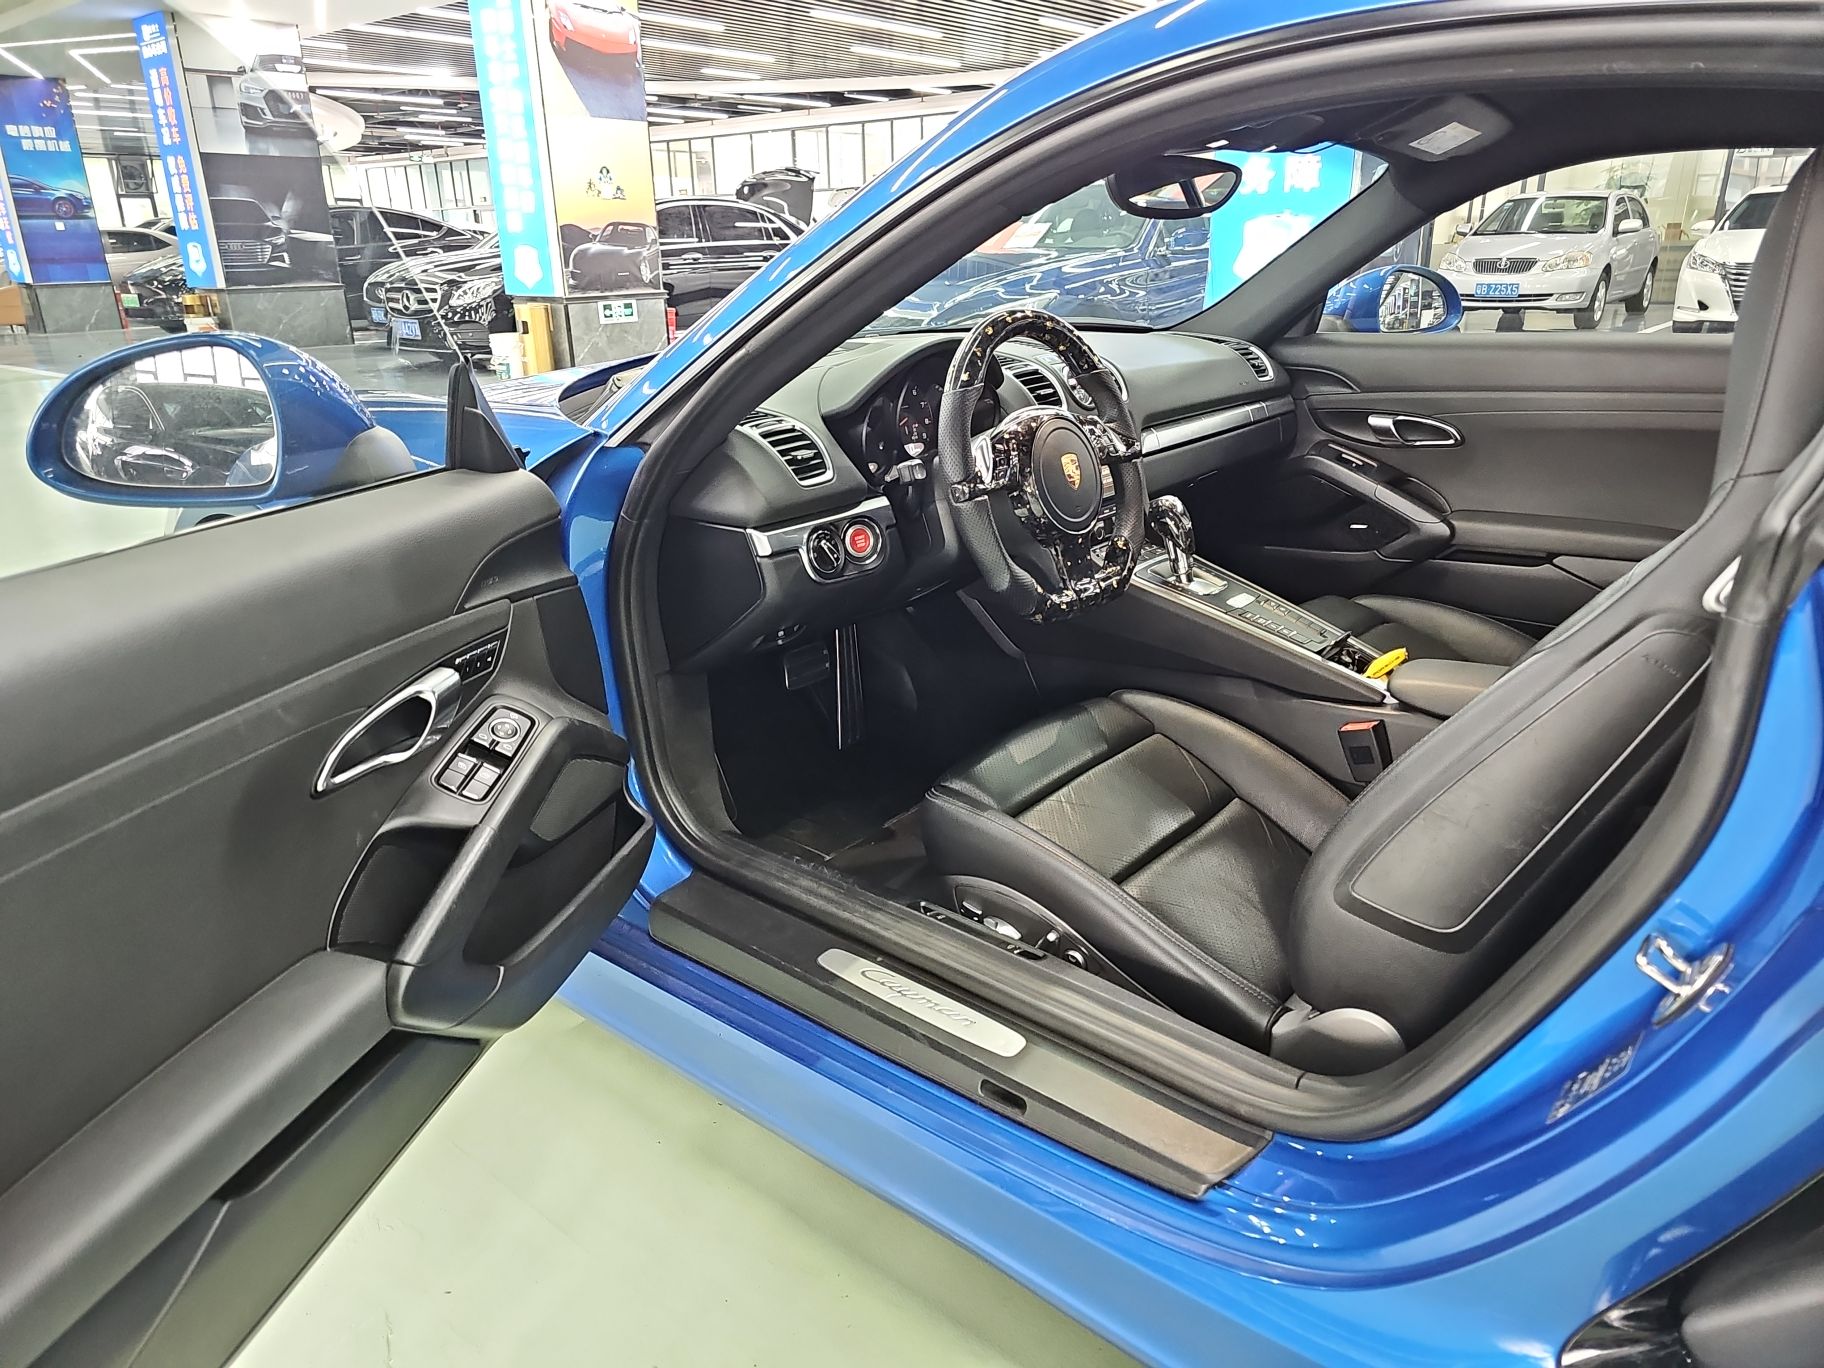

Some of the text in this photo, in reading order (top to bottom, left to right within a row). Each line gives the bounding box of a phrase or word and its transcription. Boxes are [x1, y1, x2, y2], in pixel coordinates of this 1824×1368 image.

[159, 67, 181, 145] 高价收车
[860, 968, 977, 1026] Cayman
